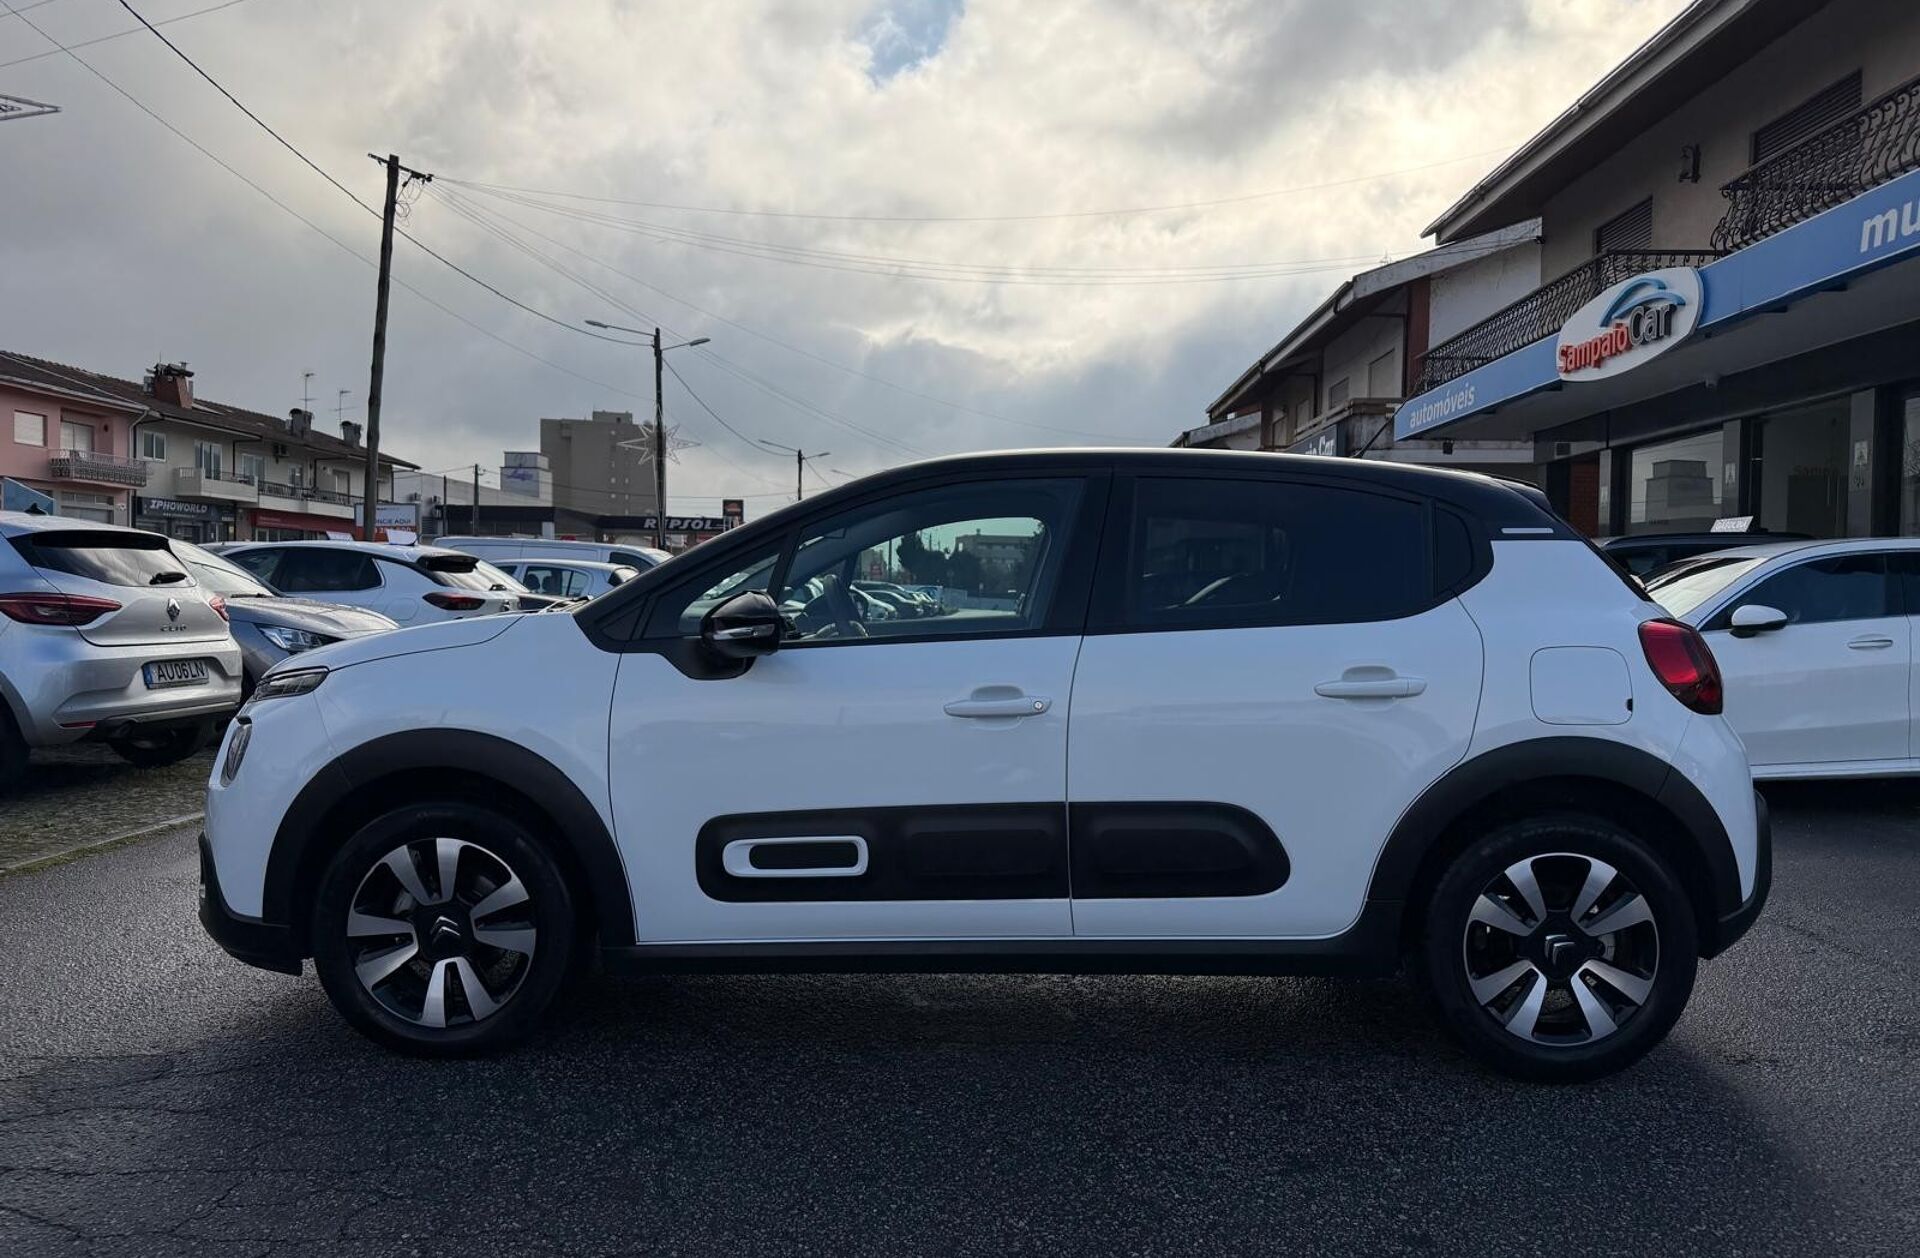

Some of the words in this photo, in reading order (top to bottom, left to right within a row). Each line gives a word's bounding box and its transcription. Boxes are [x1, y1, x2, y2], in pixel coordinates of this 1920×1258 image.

[1410, 382, 1475, 429] automóveis
[643, 518, 714, 530] RPSOL
[158, 662, 205, 681] AU06LN
